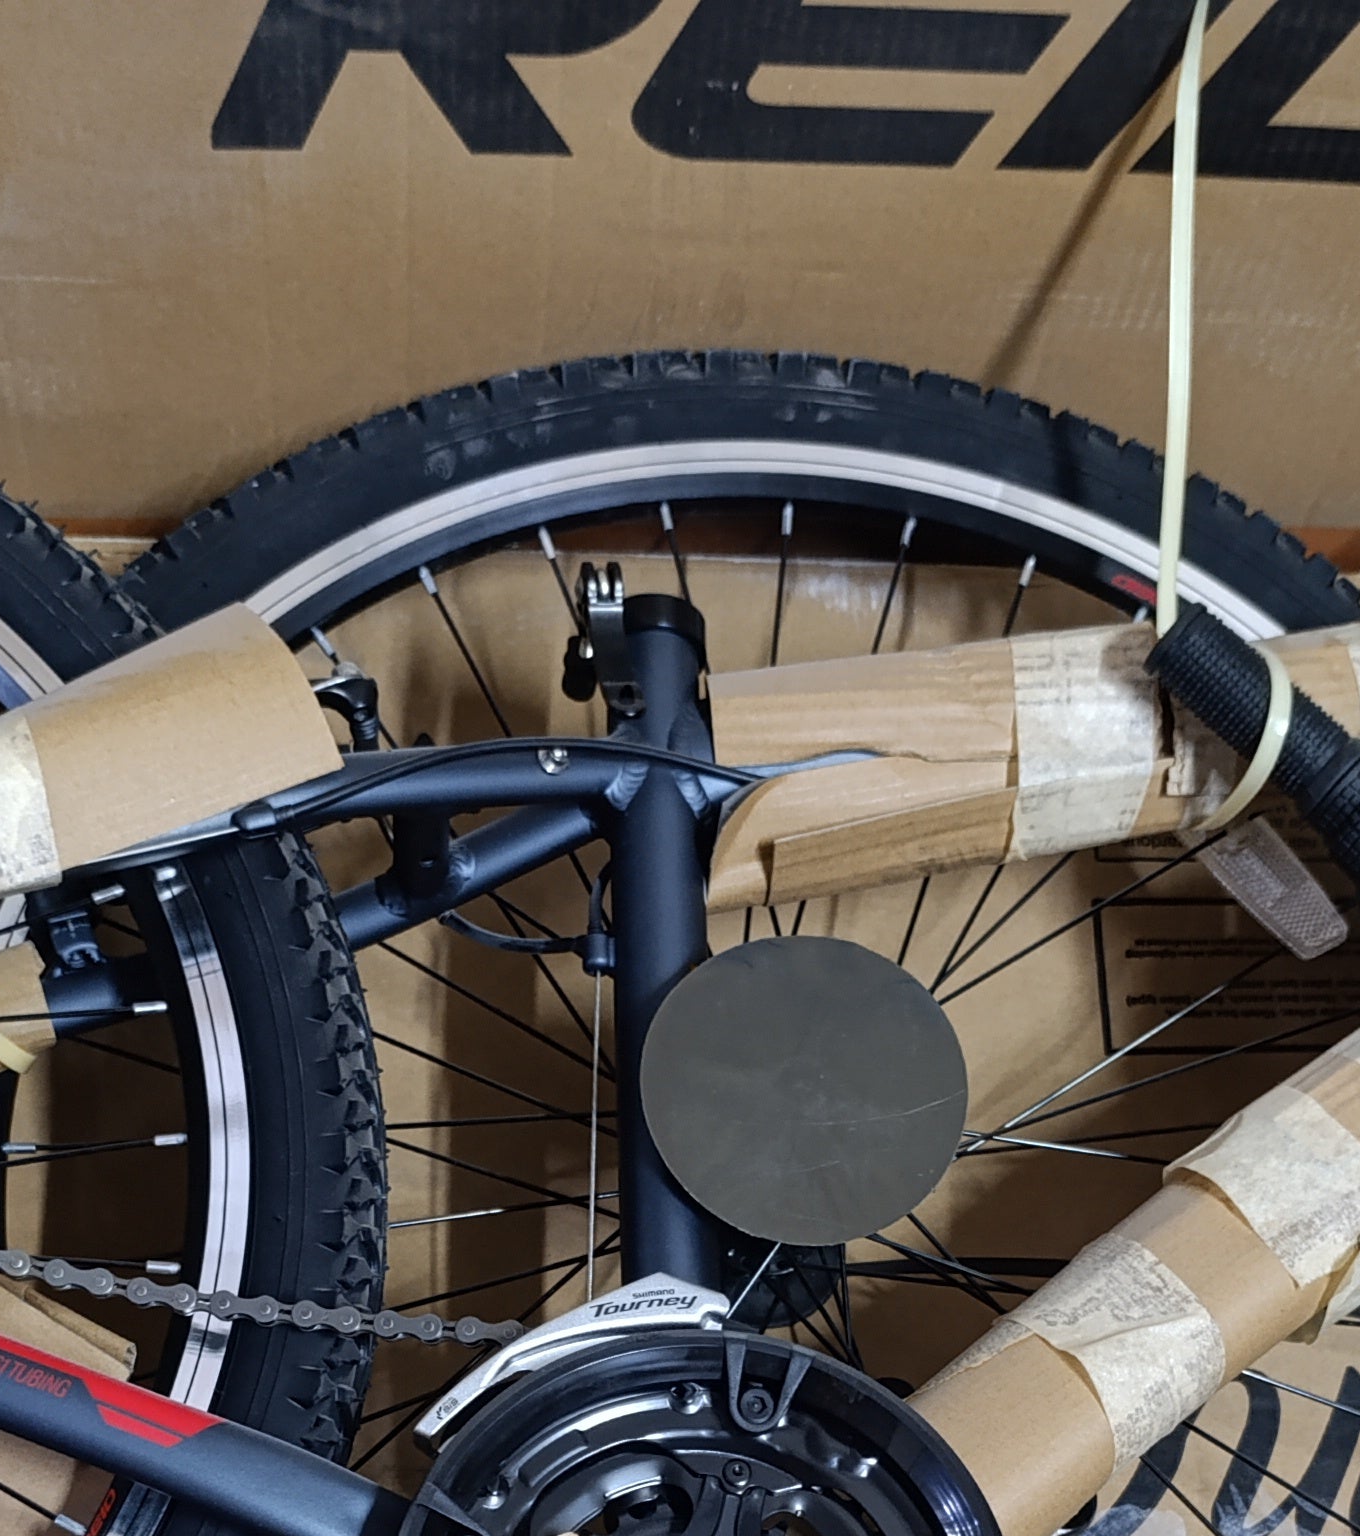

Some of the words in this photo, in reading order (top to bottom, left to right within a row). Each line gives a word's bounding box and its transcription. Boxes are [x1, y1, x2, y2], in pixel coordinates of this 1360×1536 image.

[632, 1289, 675, 1299] SHIMANO
[590, 1295, 697, 1318] Tourney
[6, 1361, 73, 1398] TUBING
